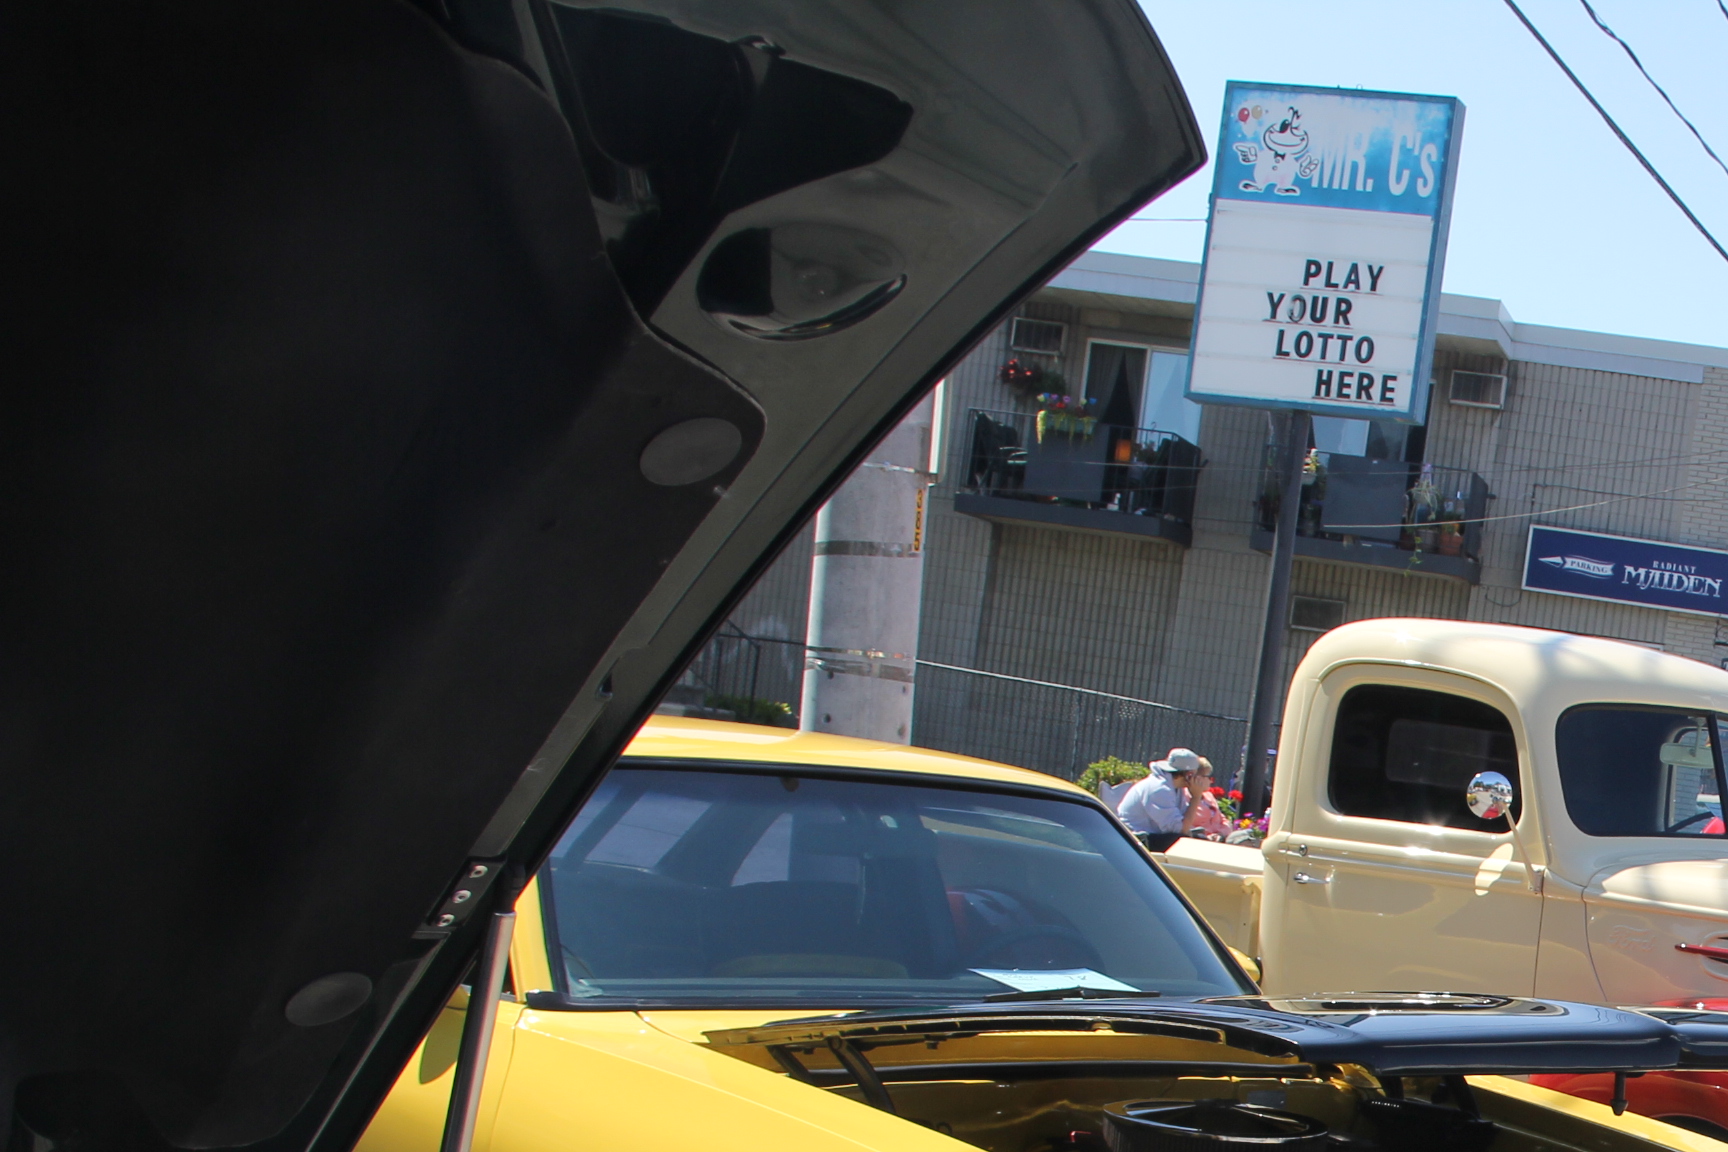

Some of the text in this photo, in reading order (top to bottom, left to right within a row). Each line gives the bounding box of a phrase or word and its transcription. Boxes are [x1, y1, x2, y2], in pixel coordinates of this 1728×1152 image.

[1303, 259, 1384, 292] PLAY
[1266, 292, 1353, 325] YOUR
[1275, 329, 1375, 364] LOTTO
[1314, 369, 1398, 403] HERE
[1570, 560, 1608, 574] PARKING
[1621, 565, 1723, 598] MAIDEN
[1652, 560, 1697, 574] RADIANT
